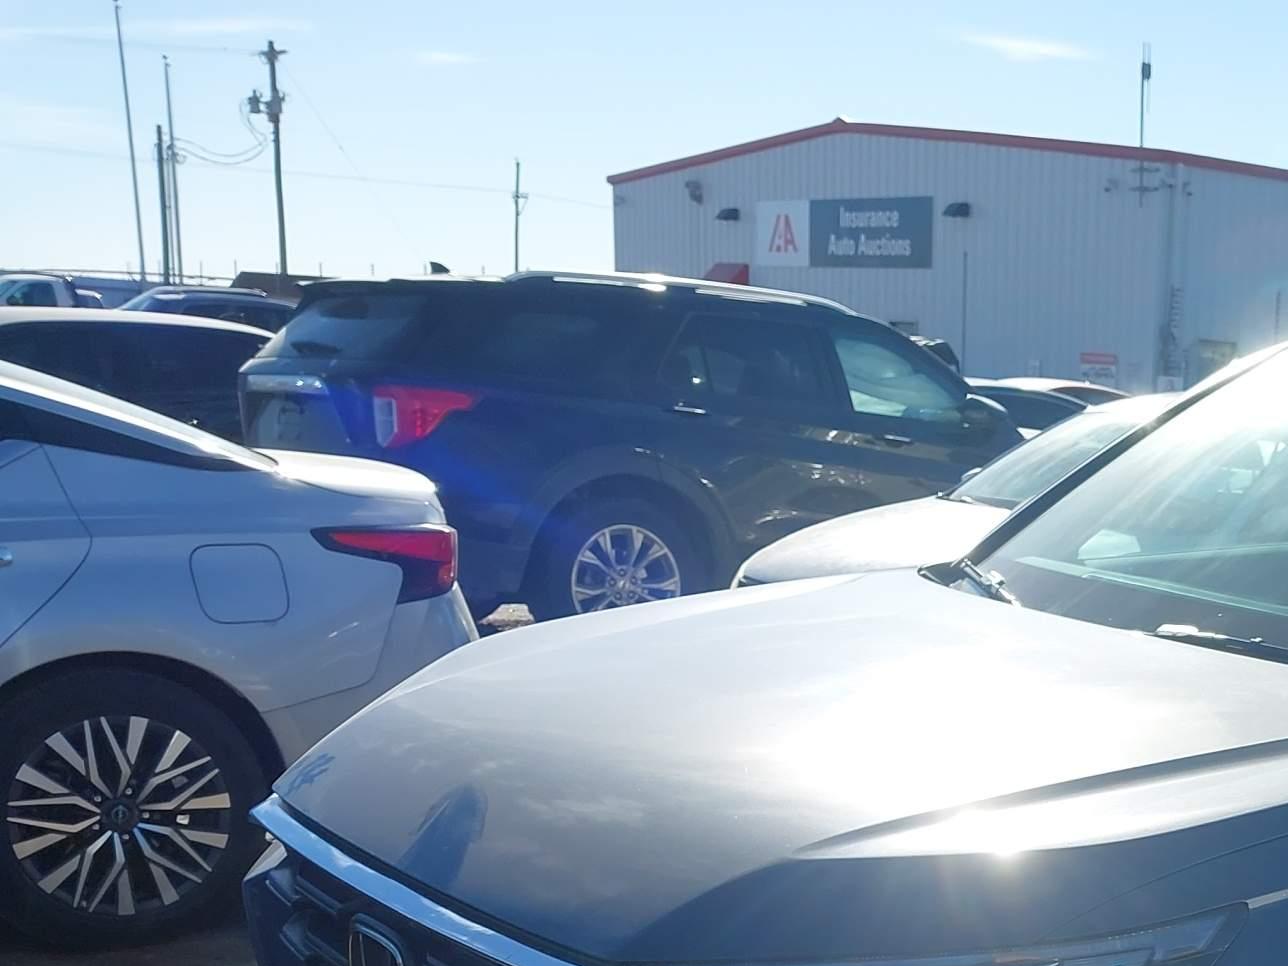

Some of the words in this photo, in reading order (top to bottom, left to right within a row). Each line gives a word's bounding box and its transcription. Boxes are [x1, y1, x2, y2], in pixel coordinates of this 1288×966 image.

[840, 206, 899, 228] Insurance
[827, 234, 856, 256] Auto
[858, 232, 912, 256] Auctions
